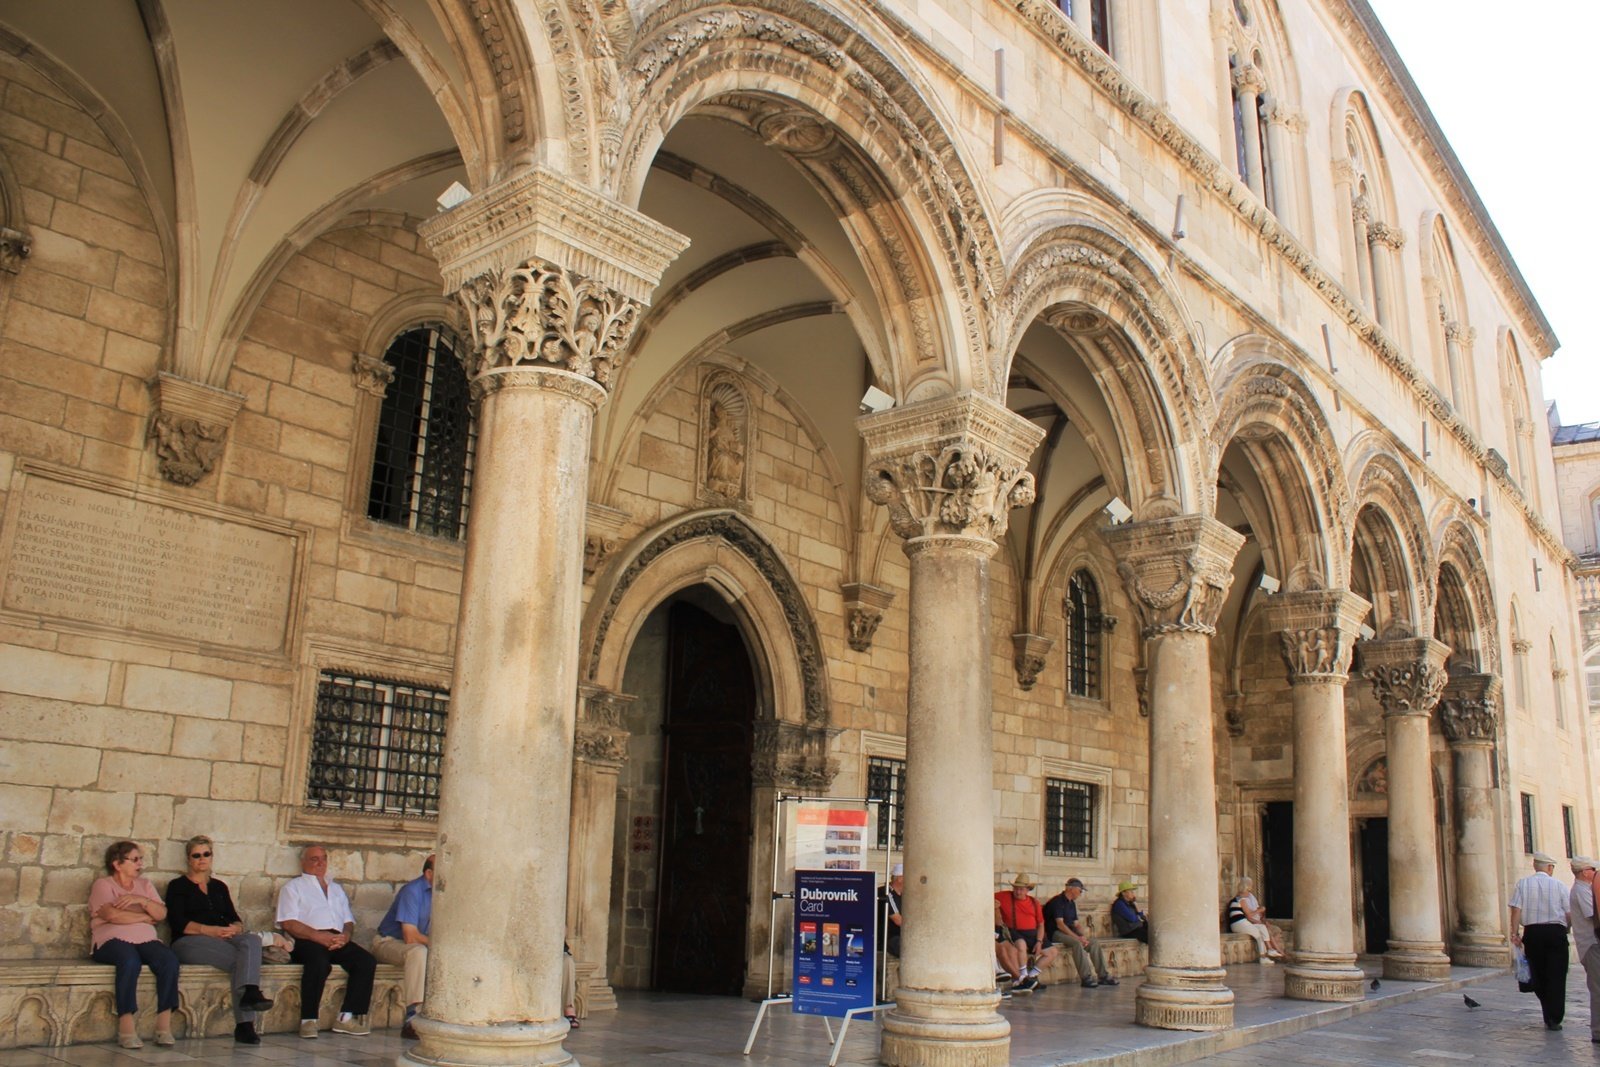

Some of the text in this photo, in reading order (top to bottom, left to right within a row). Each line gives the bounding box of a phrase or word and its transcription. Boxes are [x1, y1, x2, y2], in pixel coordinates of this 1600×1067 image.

[800, 887, 858, 902] Dubrovnik
[800, 900, 823, 912] Card
[823, 933, 831, 946] 3
[846, 934, 854, 947] 7
